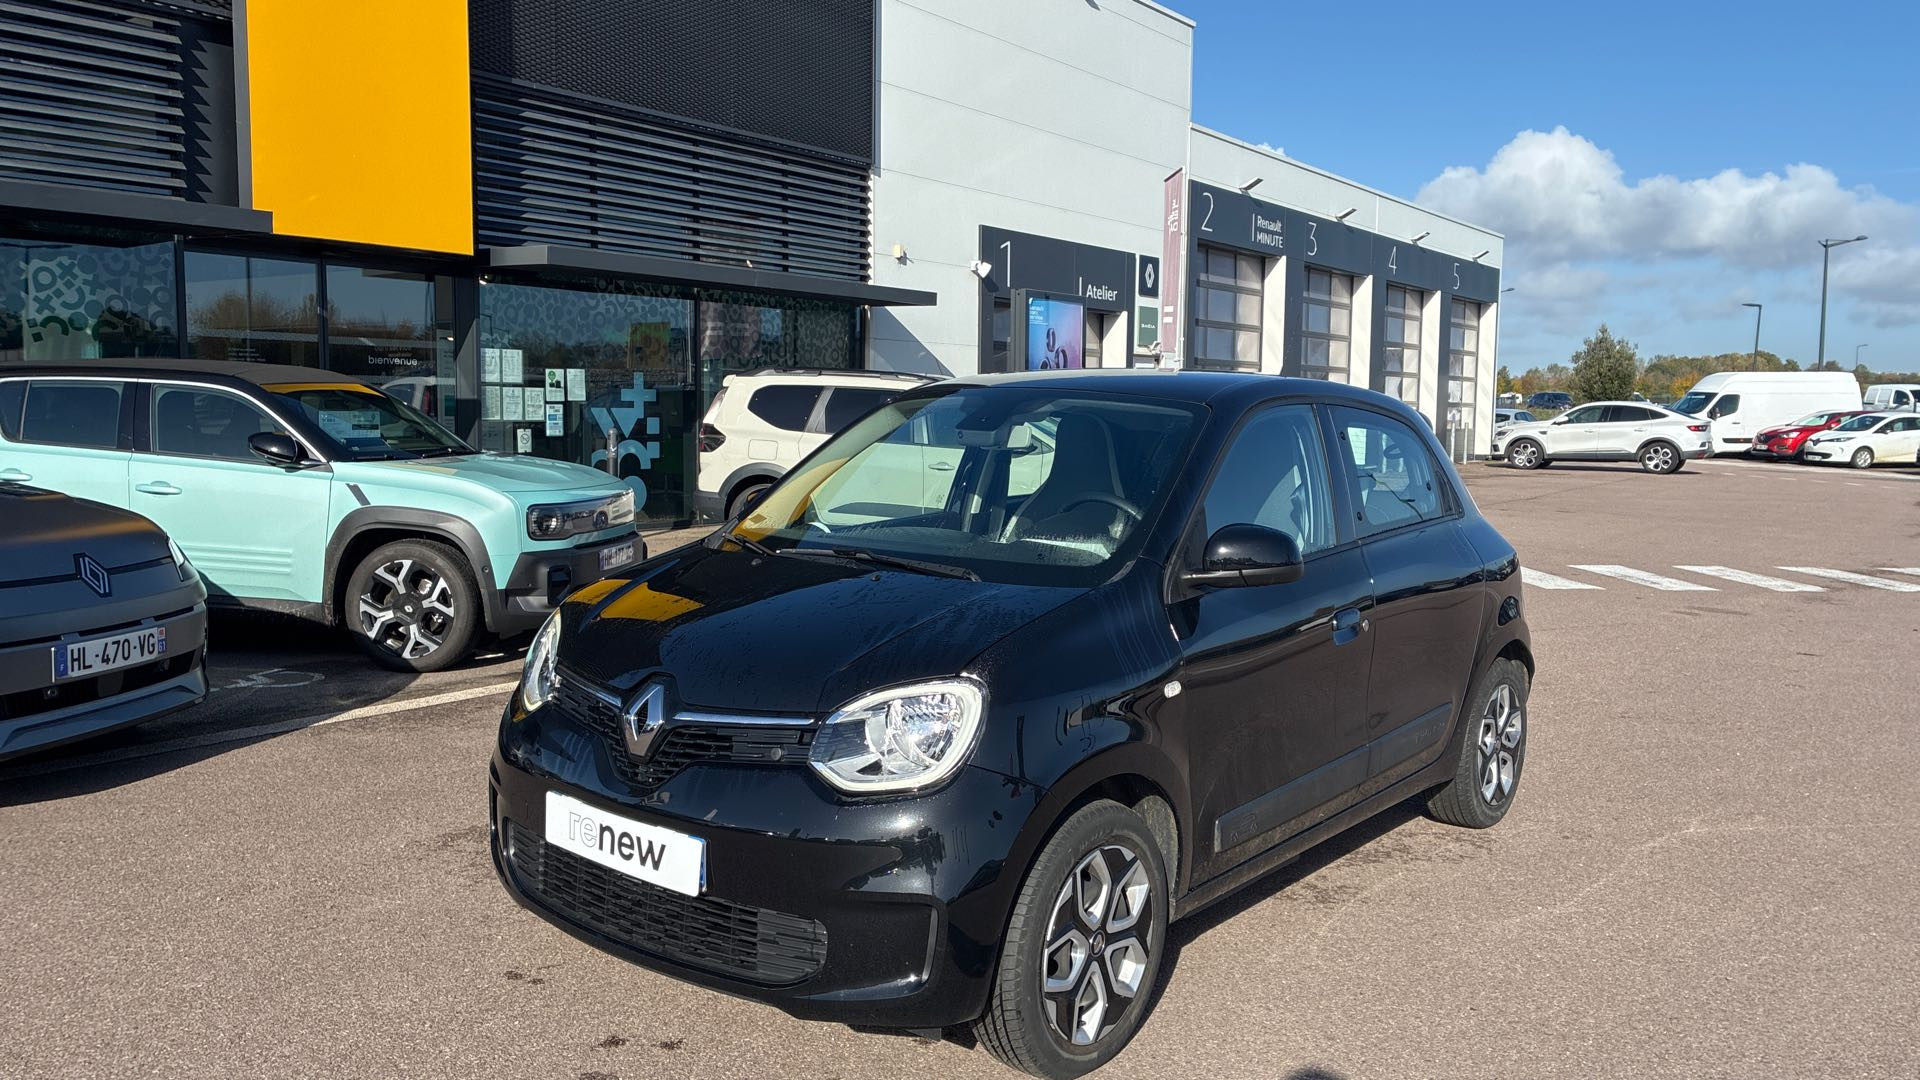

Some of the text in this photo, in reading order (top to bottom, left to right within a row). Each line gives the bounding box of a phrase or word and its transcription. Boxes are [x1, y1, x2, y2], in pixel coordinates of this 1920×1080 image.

[1201, 192, 1214, 232] 2
[1257, 215, 1282, 233] Renault
[1256, 232, 1284, 249] MINUTE
[1307, 221, 1318, 257] 3
[1000, 240, 1011, 288] 1
[1388, 245, 1398, 276] 4
[1453, 262, 1460, 290] 5
[1086, 284, 1118, 302] Atelier
[368, 355, 418, 366] bienvenue
[70, 633, 156, 673] HL-470-VG
[569, 812, 666, 871] renew
